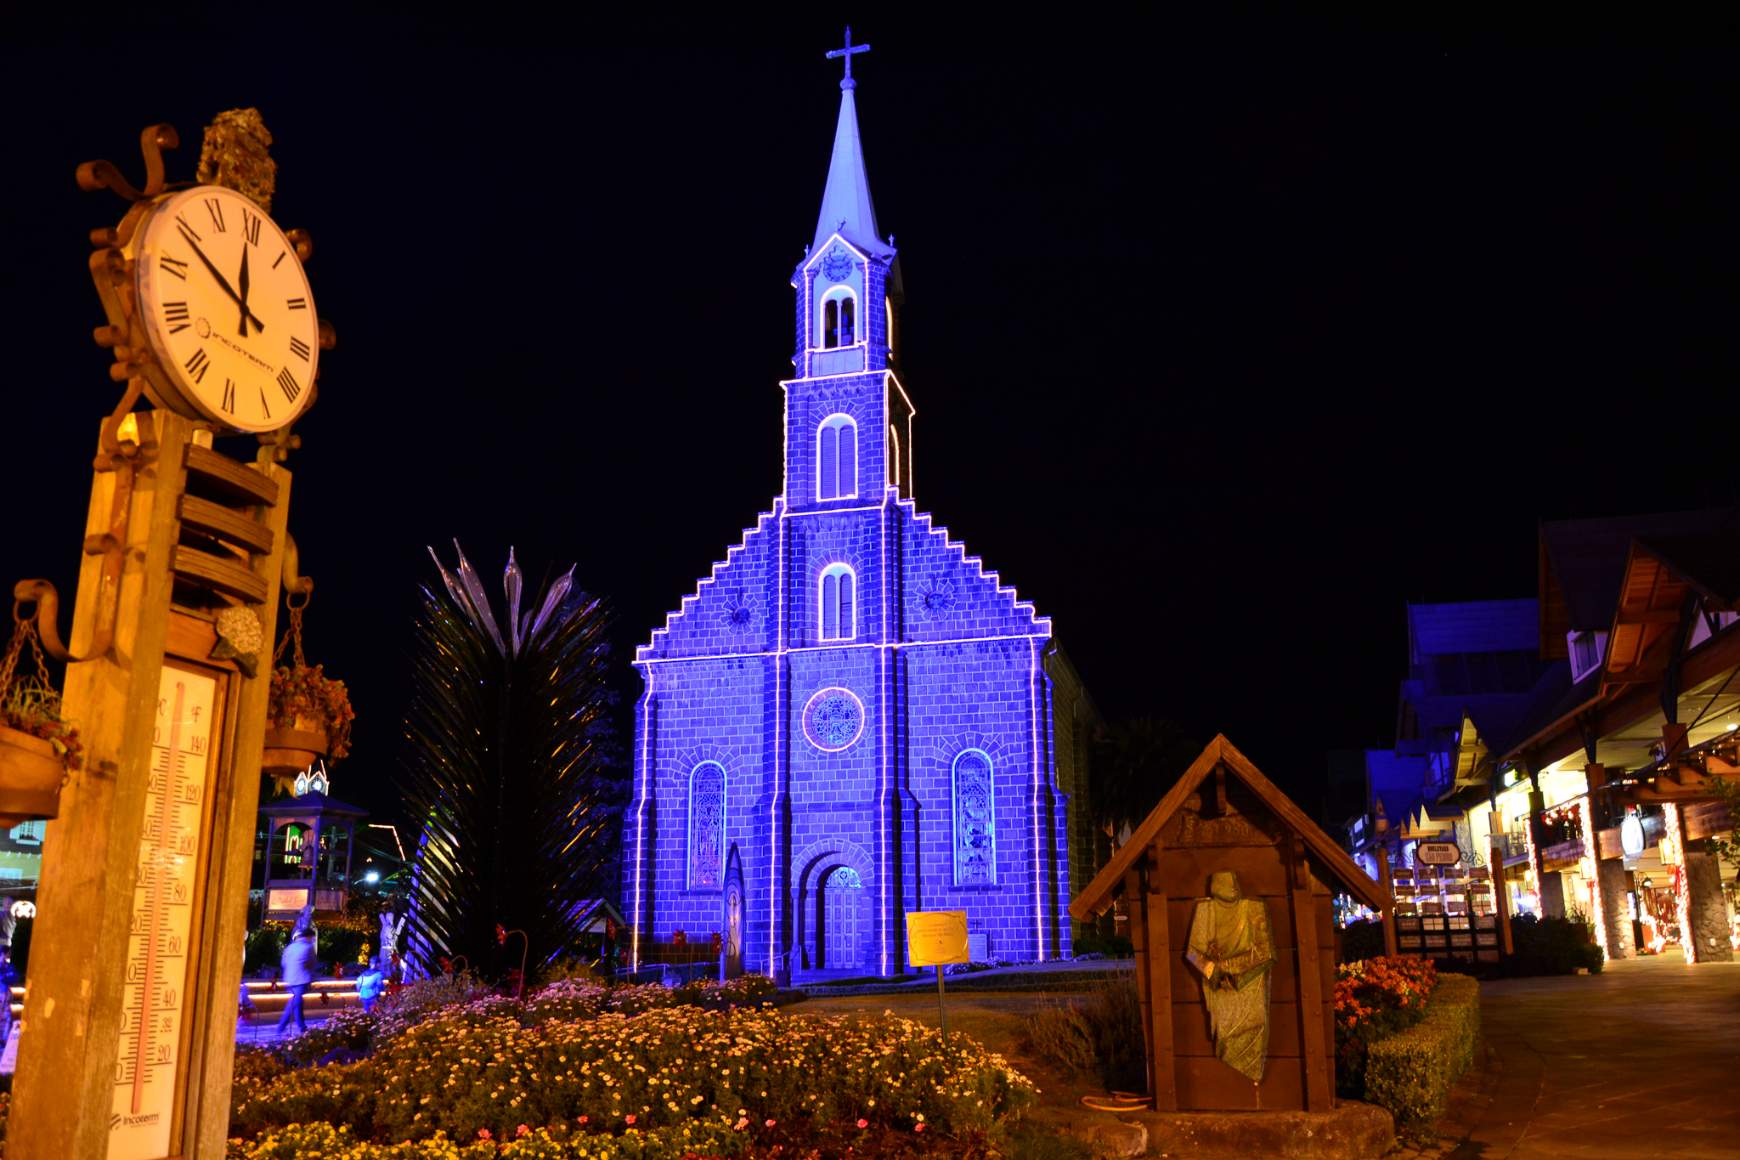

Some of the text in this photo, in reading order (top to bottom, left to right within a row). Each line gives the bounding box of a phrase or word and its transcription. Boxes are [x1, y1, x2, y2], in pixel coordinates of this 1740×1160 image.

[205, 198, 226, 233] XI
[242, 208, 261, 248] XII
[160, 250, 188, 281] IX
[287, 298, 306, 310] II
[162, 302, 191, 334] VIII
[290, 336, 310, 362] III
[185, 348, 211, 384] VII
[221, 378, 236, 415] VI
[190, 735, 207, 754] 140
[185, 784, 201, 802] 120
[179, 835, 196, 853] 100
[174, 884, 187, 903] 80
[168, 936, 181, 954] 60
[162, 989, 177, 1008] 40
[157, 1044, 171, 1063] 20
